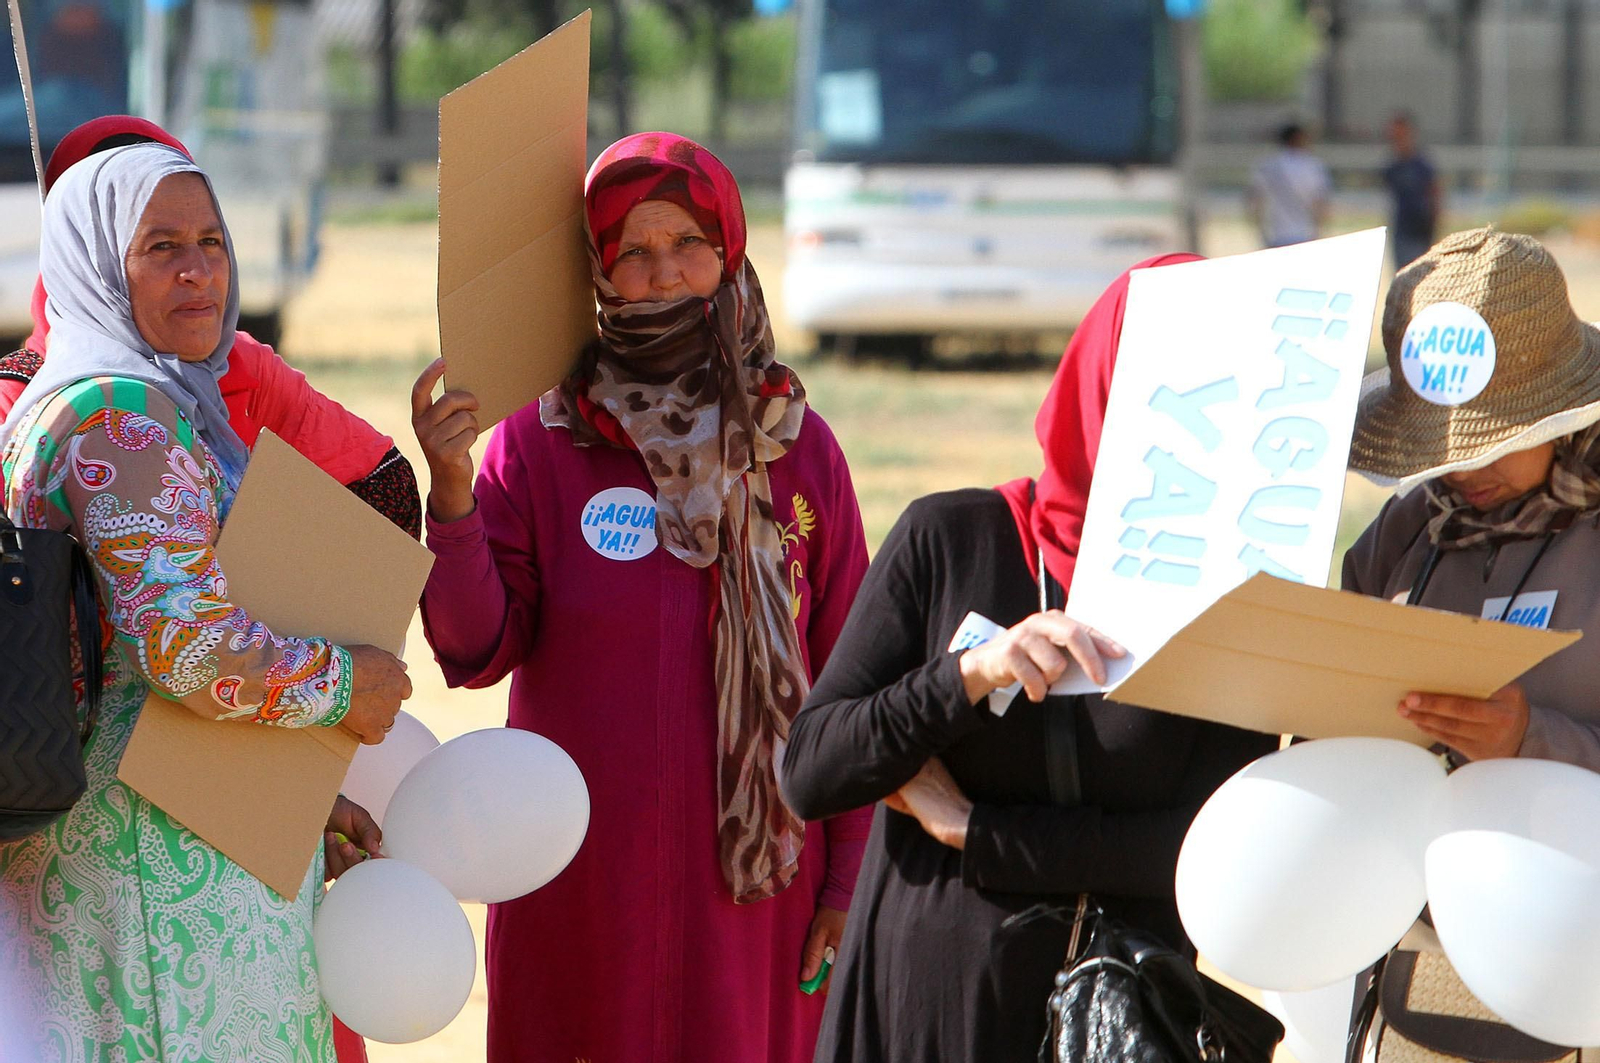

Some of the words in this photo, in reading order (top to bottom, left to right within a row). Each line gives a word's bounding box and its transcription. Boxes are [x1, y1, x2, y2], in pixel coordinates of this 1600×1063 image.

[1404, 325, 1485, 359] ¡¡AGUA
[1420, 363, 1469, 394] YA!!
[1111, 375, 1240, 587] YA!!
[583, 503, 656, 530] ¡¡AGUA
[597, 528, 640, 554] YA!!
